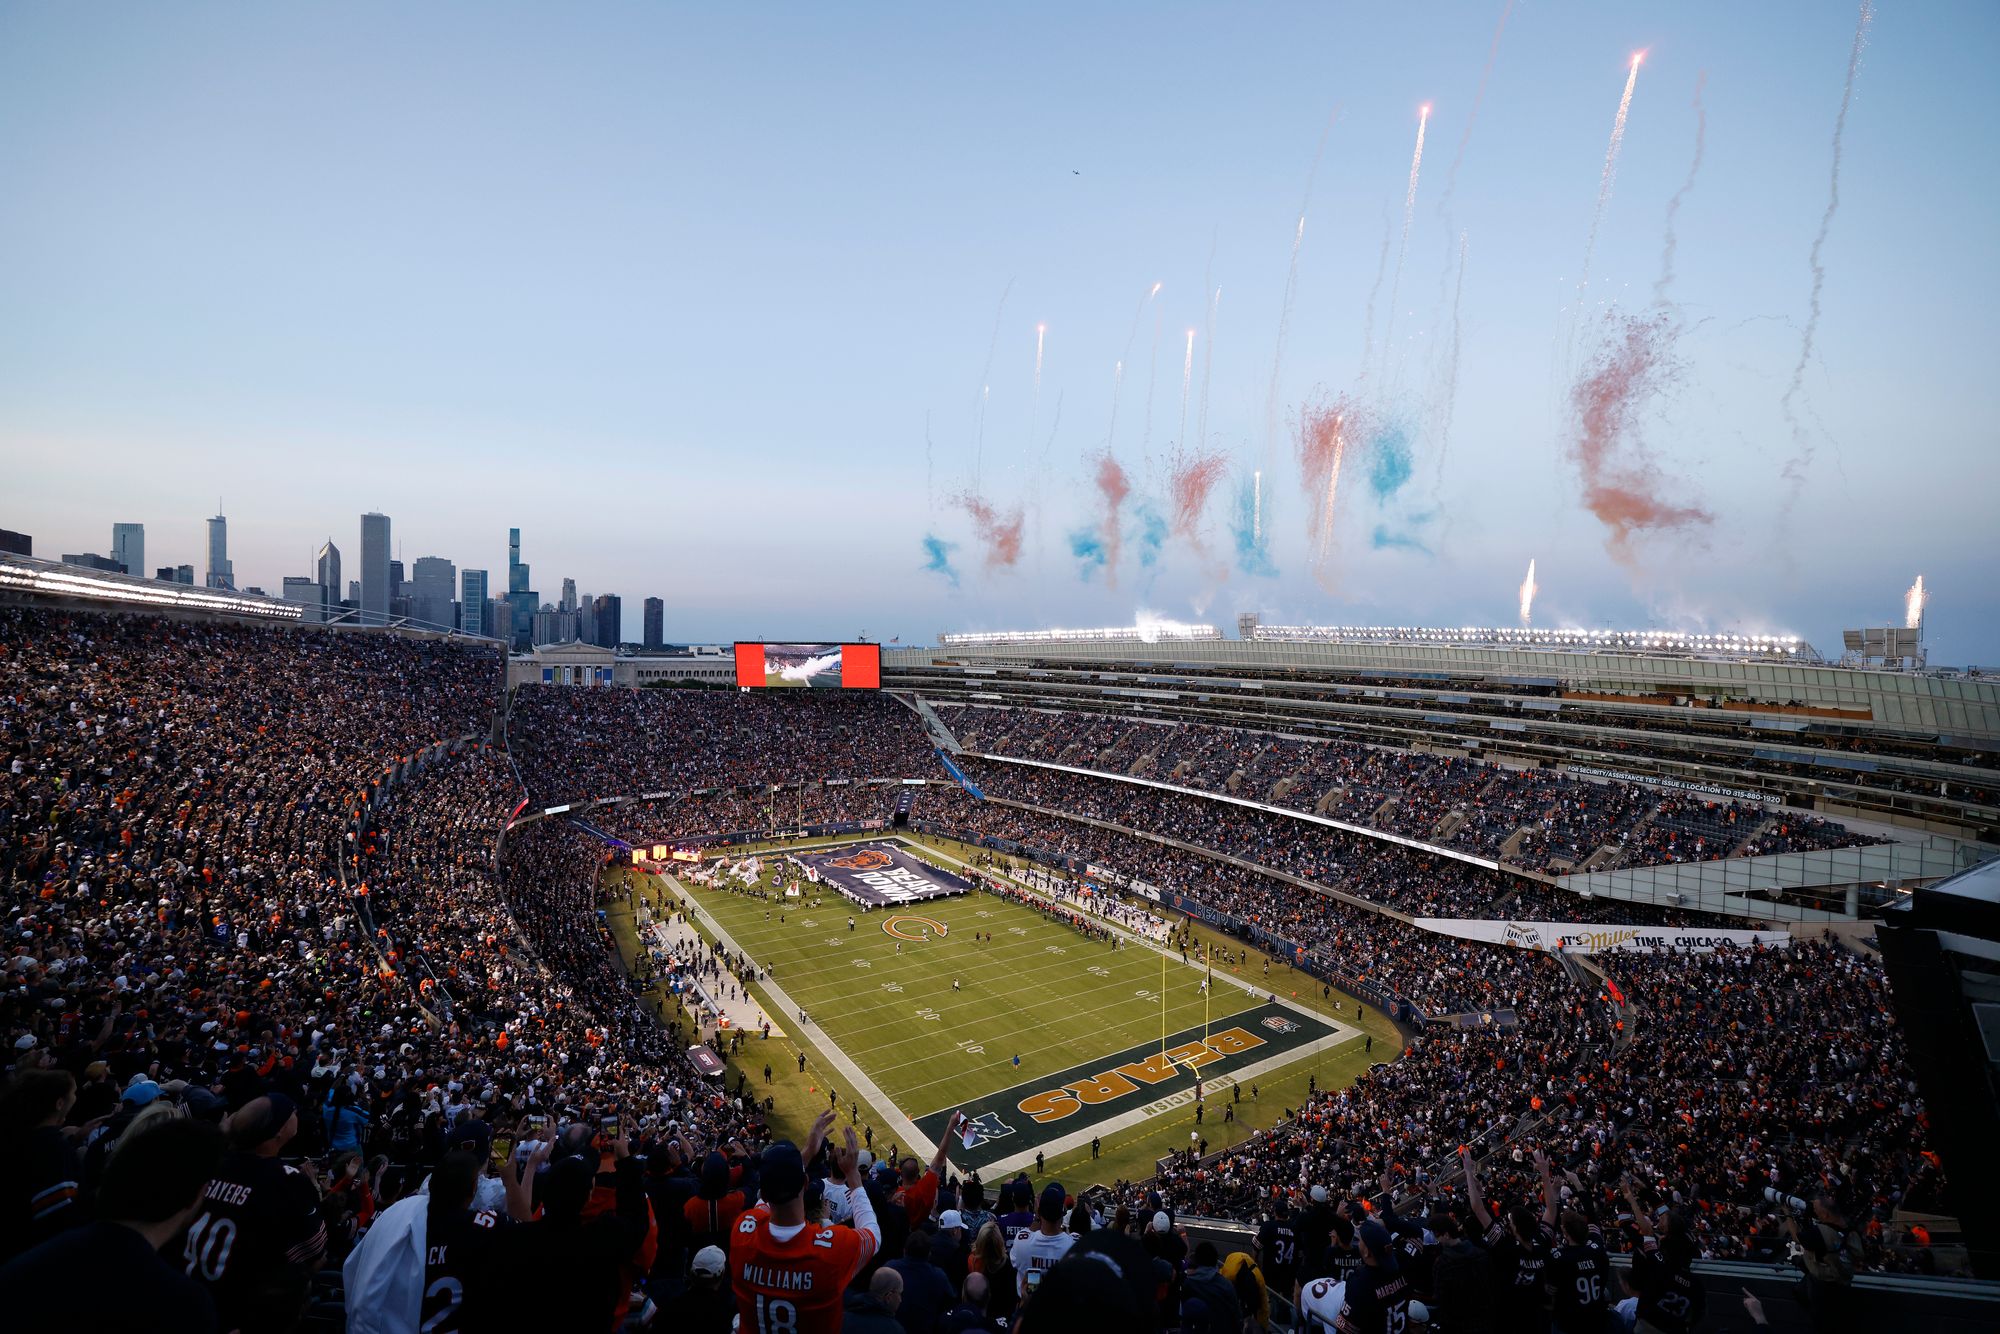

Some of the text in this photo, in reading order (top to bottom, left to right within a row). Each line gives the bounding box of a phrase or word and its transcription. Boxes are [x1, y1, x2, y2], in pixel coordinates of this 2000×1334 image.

[1567, 765, 1579, 773] FOR
[1579, 766, 1644, 783] SECURITY/ASSISTANCE
[1645, 777, 1660, 785] TEXT
[1661, 779, 1680, 788] ISSUE
[1687, 783, 1720, 795] LOCATION
[1722, 788, 1732, 797] TO
[642, 791, 671, 800] DOWN
[850, 871, 920, 901] DOWN
[881, 866, 940, 894] BEAR
[1579, 929, 1640, 953] Miller
[1135, 989, 1160, 1003] 10
[916, 1007, 941, 1021] 20
[700, 1053, 713, 1066] ESPN
[956, 1039, 985, 1055] 10
[1017, 1026, 1268, 1124] BEARS
[1204, 1075, 1237, 1091] END
[1141, 1086, 1203, 1116] ACISM
[472, 1208, 498, 1230] 5
[182, 1211, 238, 1282] 40
[814, 1228, 834, 1249] 18
[1031, 1255, 1058, 1270] WILLI
[1274, 1239, 1296, 1265] 34
[1334, 1256, 1363, 1267] WILLIAMS
[1577, 1259, 1596, 1271] HICKS
[743, 1263, 813, 1291] WILLIAMS
[1375, 1274, 1408, 1300] MARSHALL
[1576, 1274, 1601, 1305] 96
[421, 1275, 464, 1334] 2
[755, 1293, 798, 1334] 18
[1385, 1299, 1406, 1334] 15
[1656, 1290, 1691, 1319] 23
